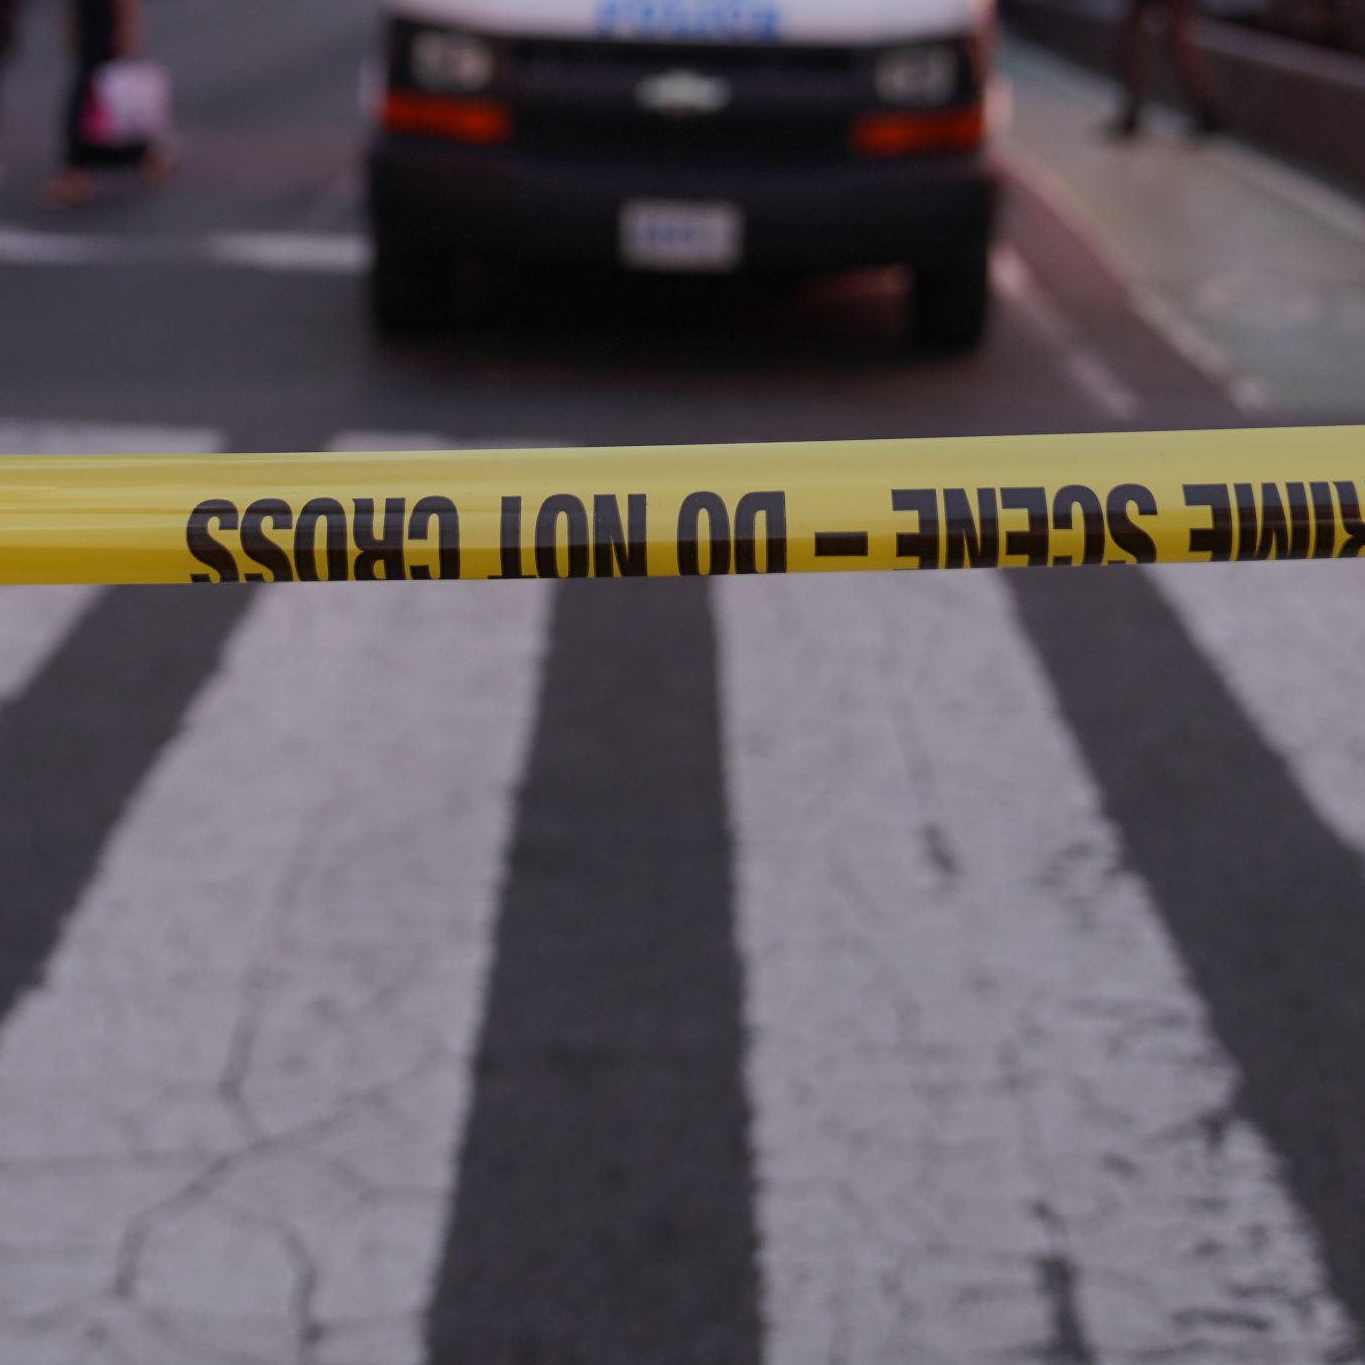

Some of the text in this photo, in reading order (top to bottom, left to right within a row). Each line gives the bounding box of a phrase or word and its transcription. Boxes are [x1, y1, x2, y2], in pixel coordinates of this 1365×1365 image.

[186, 496, 461, 582] CROSS
[486, 494, 649, 578] NOT
[676, 491, 788, 575] DO
[891, 483, 1158, 570] SCENE
